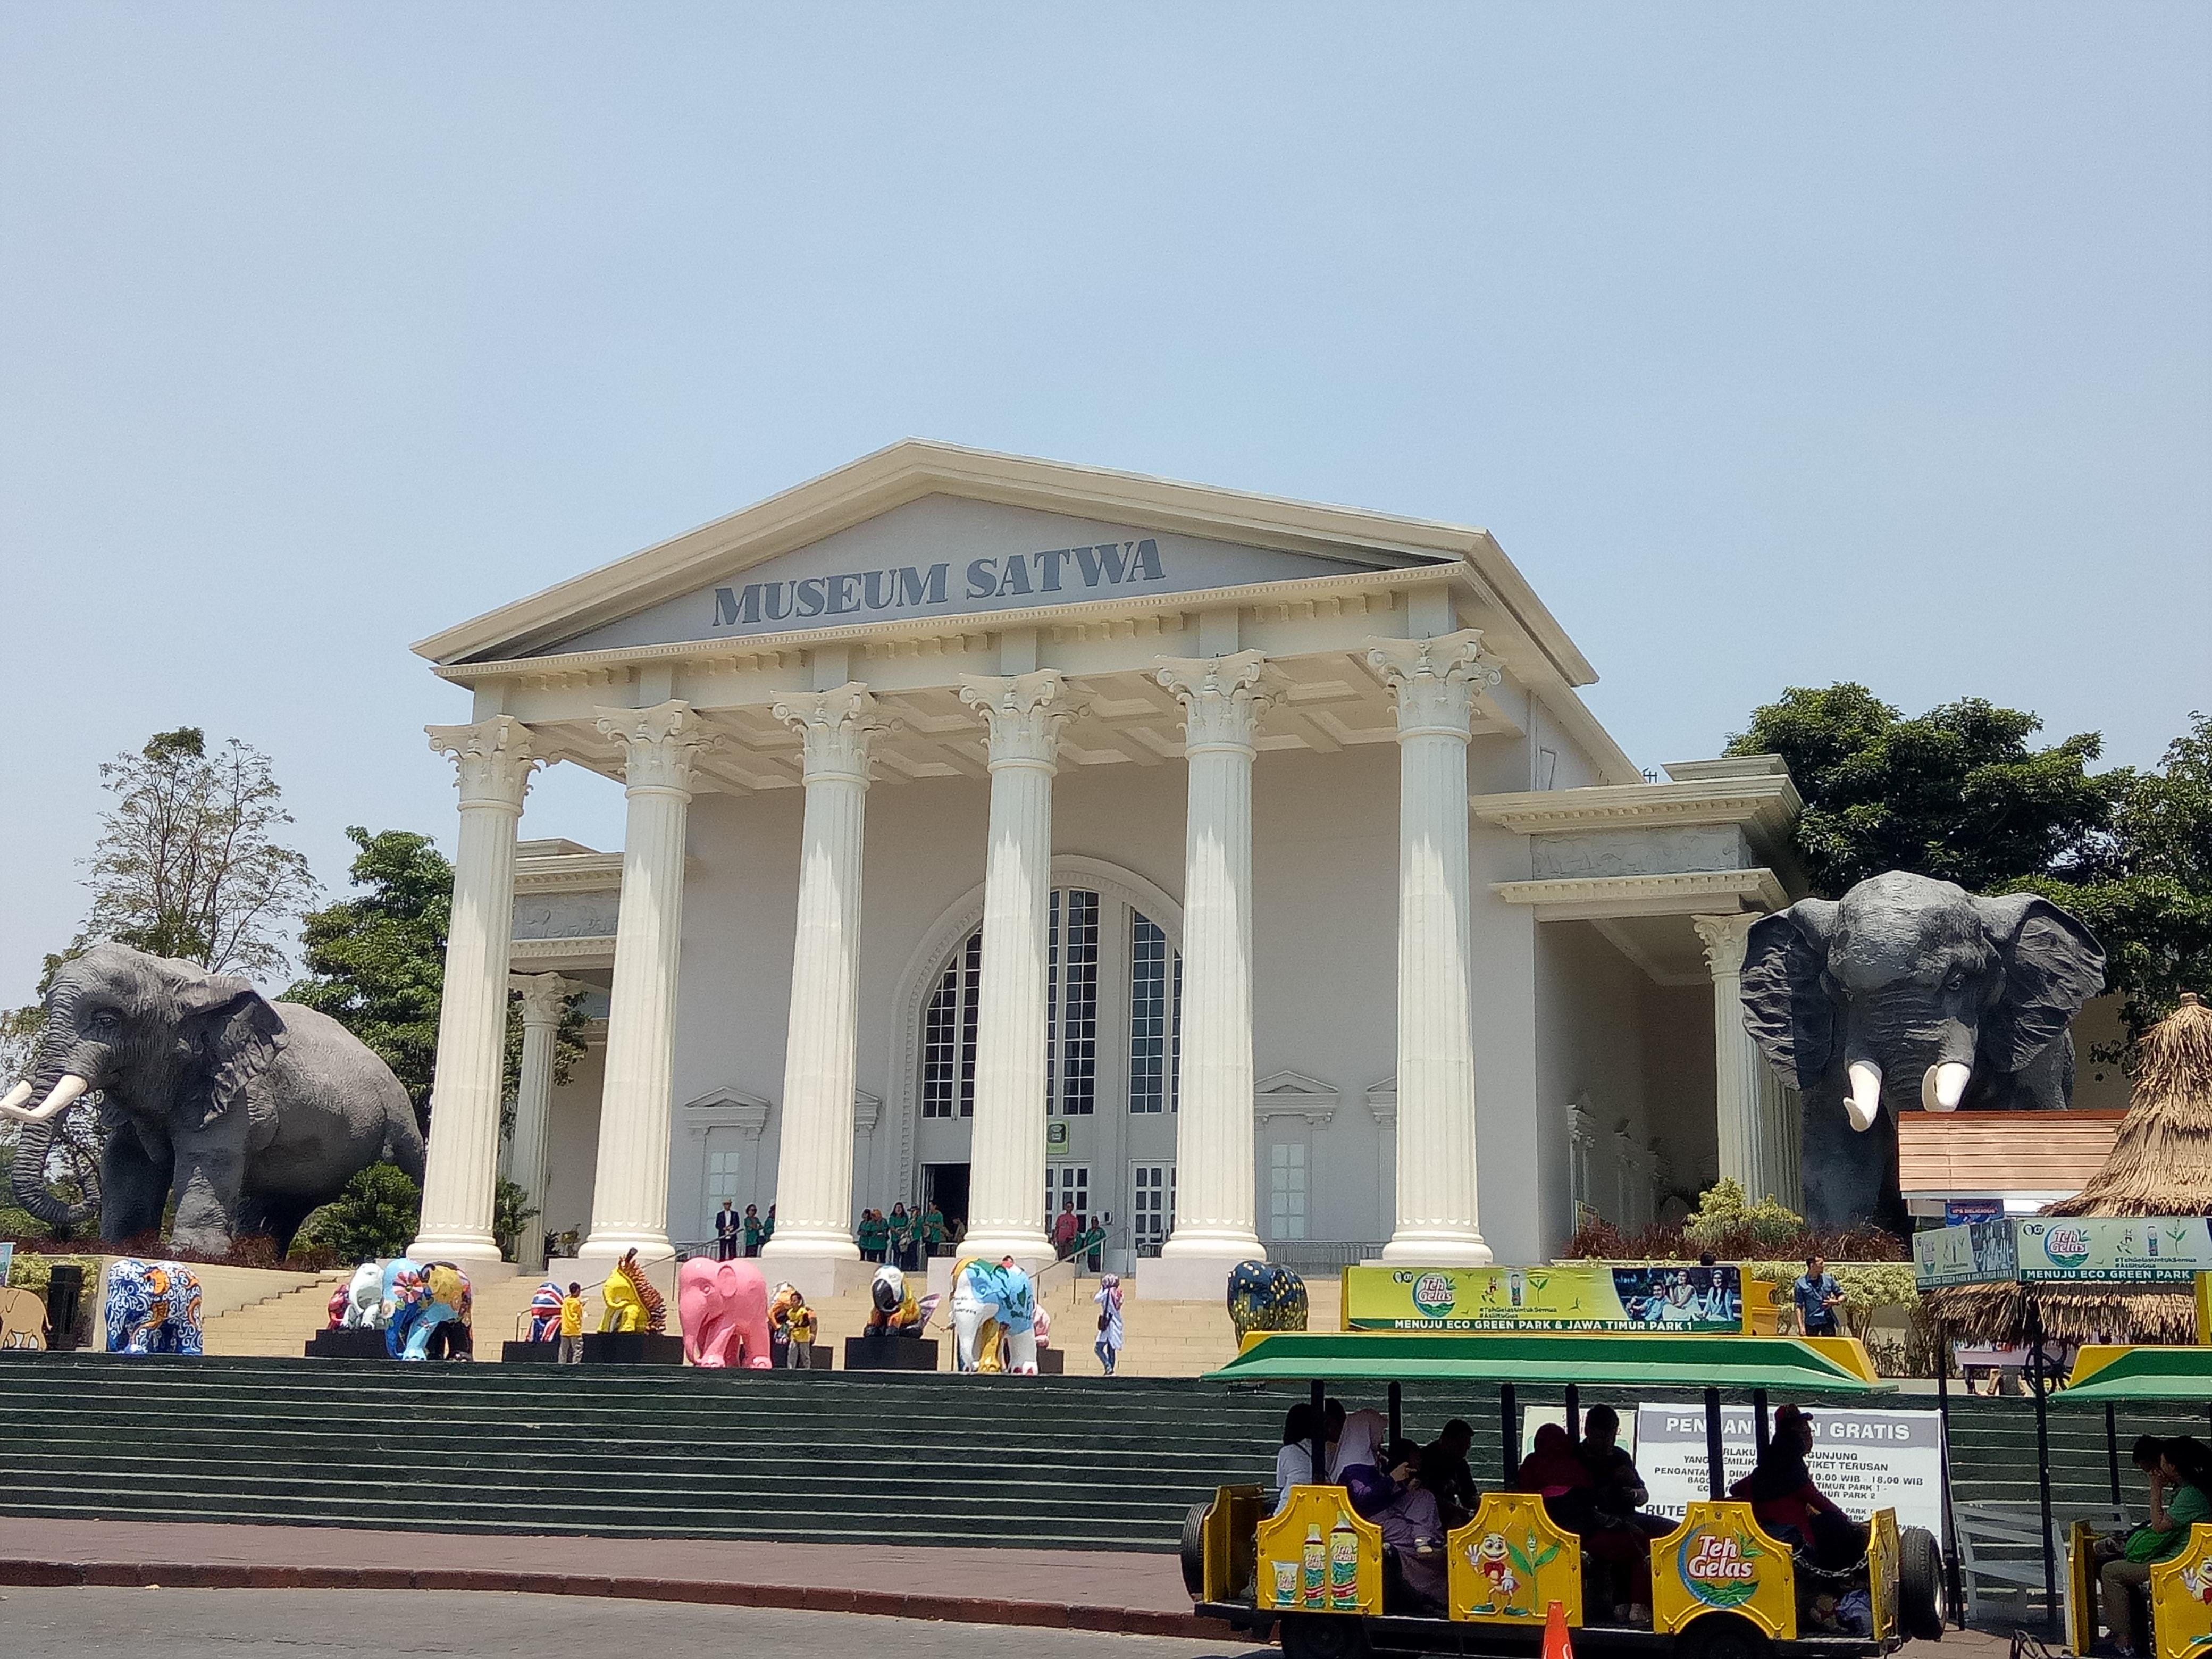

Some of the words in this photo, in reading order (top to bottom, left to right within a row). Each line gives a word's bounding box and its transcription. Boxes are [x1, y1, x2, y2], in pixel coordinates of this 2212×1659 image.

[711, 563, 950, 627] MUSEUM
[965, 538, 1166, 600] SATWA
[2055, 1229, 2078, 1242] Teh
[2049, 1241, 2085, 1253] Gelas
[2026, 1270, 2076, 1279] MENUJU
[2080, 1270, 2106, 1279] ECO
[2109, 1270, 2152, 1279] GREEN
[2156, 1270, 2190, 1279] PARK
[1423, 1277, 1445, 1291] Teh
[1418, 1289, 1453, 1302] Gelas
[1395, 1319, 1443, 1329] MENUJU
[1447, 1320, 1471, 1329] ECO
[1474, 1320, 1514, 1330] GREEN
[1519, 1321, 1551, 1330] PARK
[1554, 1321, 1563, 1329] &
[1566, 1320, 1602, 1330] JAWA
[1606, 1321, 1645, 1330] TIMUR
[1647, 1321, 1683, 1331] PARK
[1687, 1322, 1692, 1330] 1
[1830, 1422, 1910, 1440] GRATIS
[1807, 1451, 1858, 1460] GUNJUNG
[1806, 1460, 1836, 1470] TIKET
[1839, 1462, 1888, 1471] TERUSAN
[1840, 1474, 1861, 1483] WIB
[1872, 1476, 1899, 1484] 18.00
[1903, 1477, 1923, 1486] WIB
[1816, 1482, 1845, 1491] TIMUR
[1848, 1484, 1872, 1492] PARK
[1842, 1491, 1867, 1499] PARK
[1645, 1504, 1686, 1516] RUTE
[1698, 1535, 1738, 1559] Teh
[1688, 1554, 1754, 1579] Gelas
